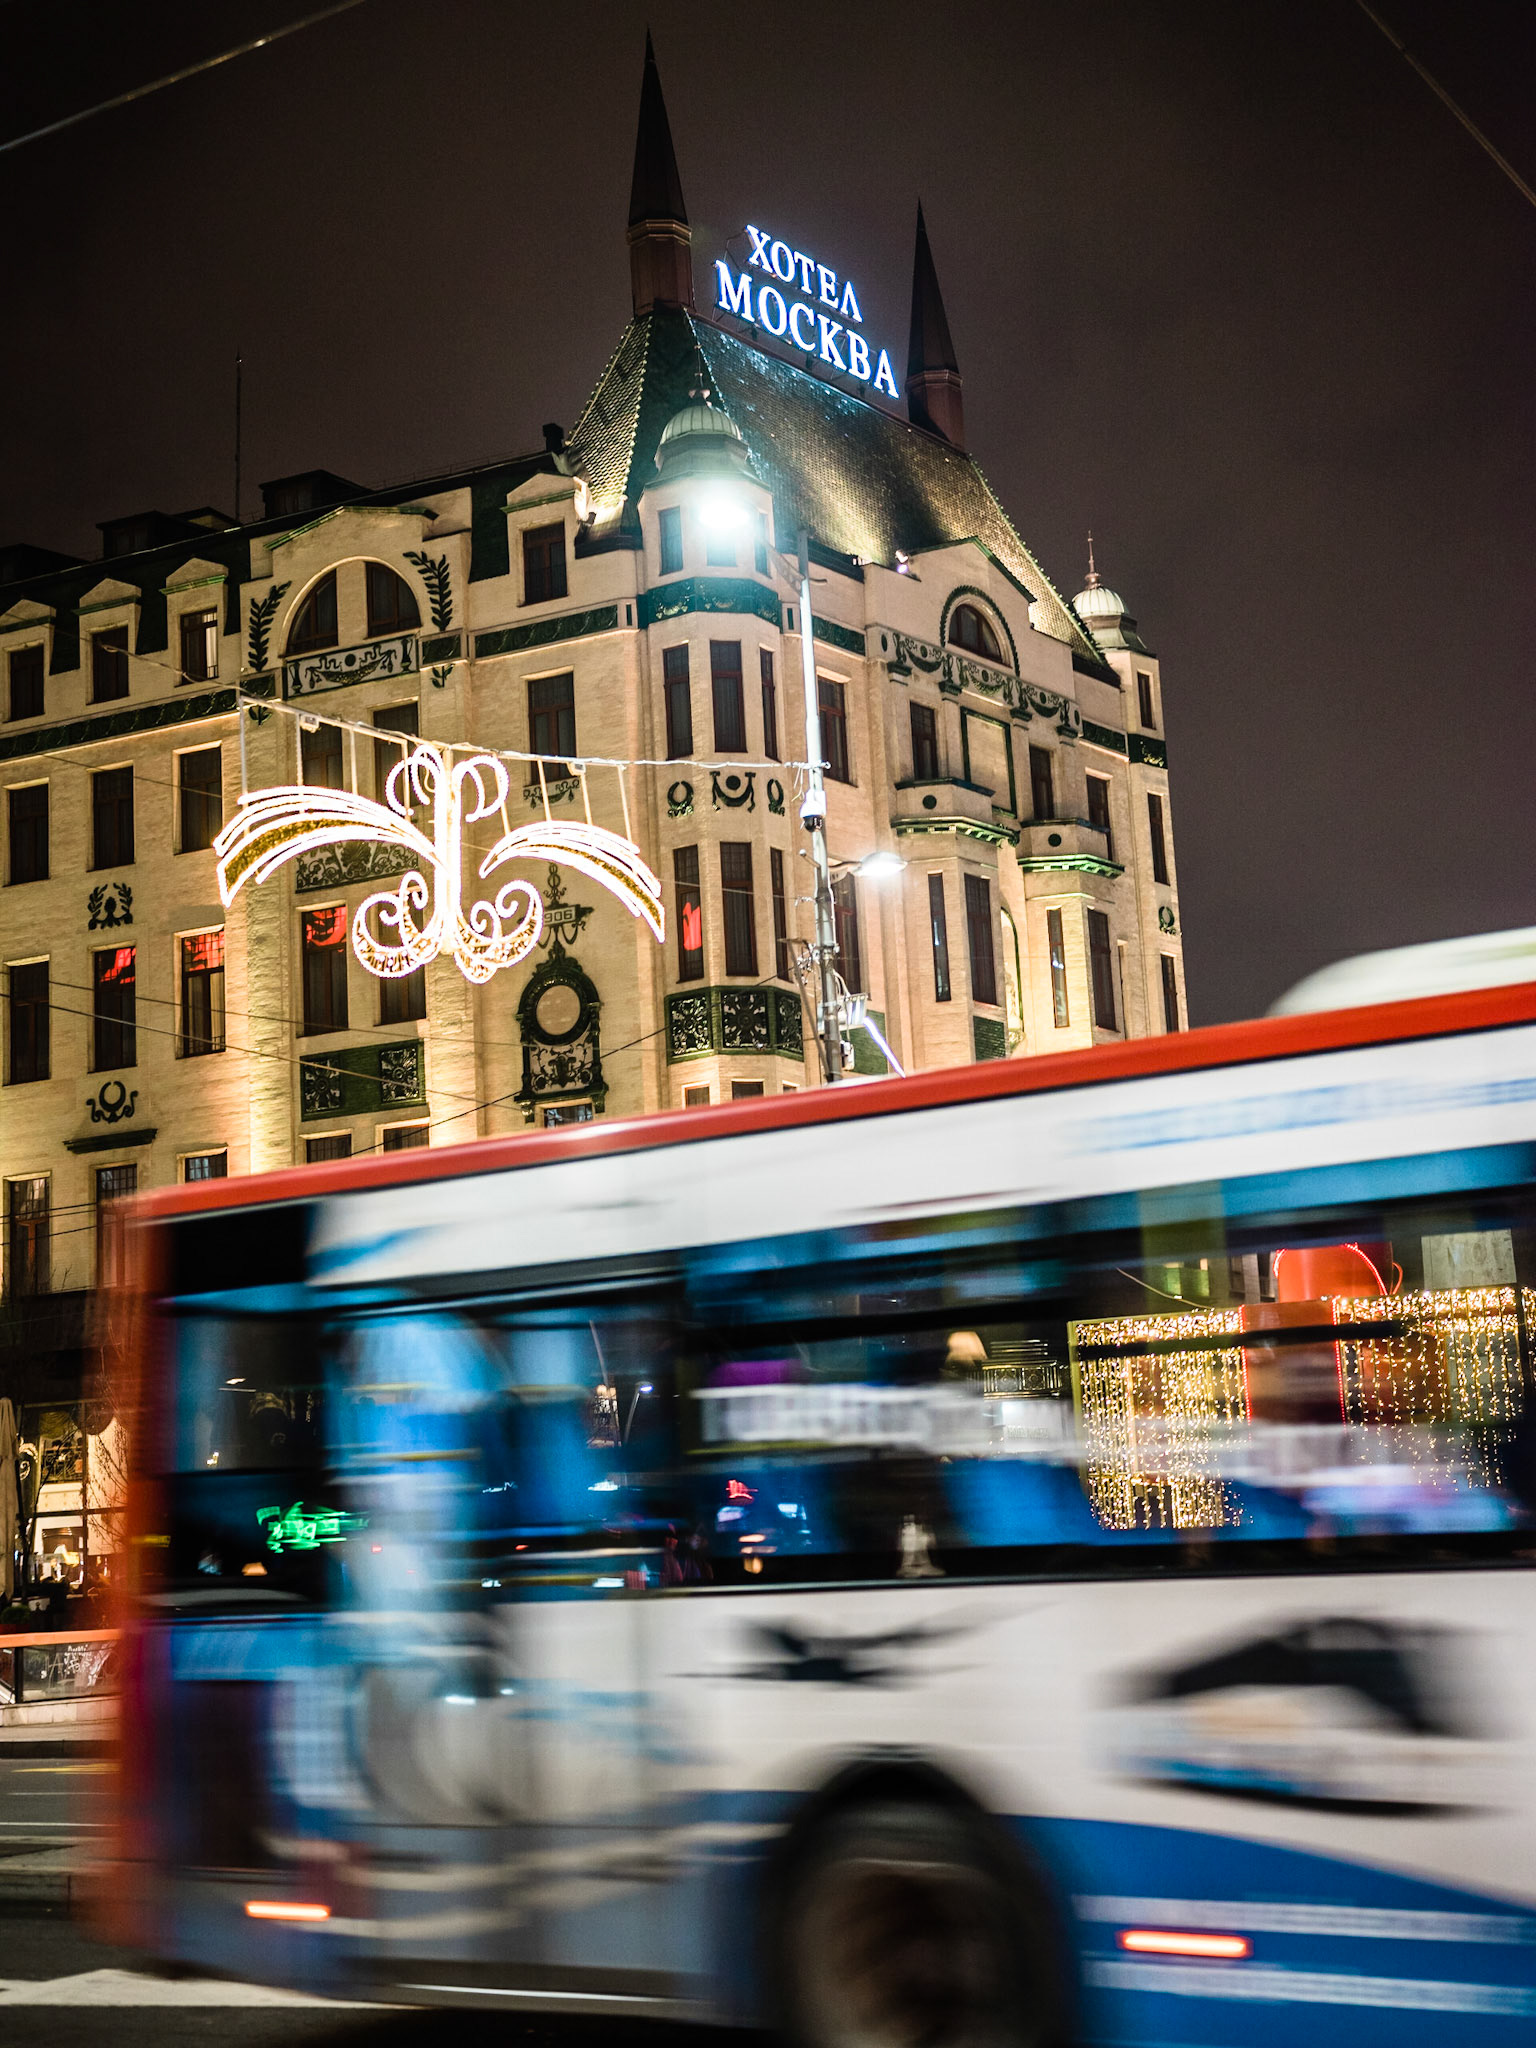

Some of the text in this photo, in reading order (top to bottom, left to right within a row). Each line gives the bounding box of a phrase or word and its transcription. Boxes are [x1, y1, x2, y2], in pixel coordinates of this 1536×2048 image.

[746, 224, 863, 323] ХОТЕЛ
[714, 259, 900, 399] МОСКВА
[544, 909, 573, 924] 906
